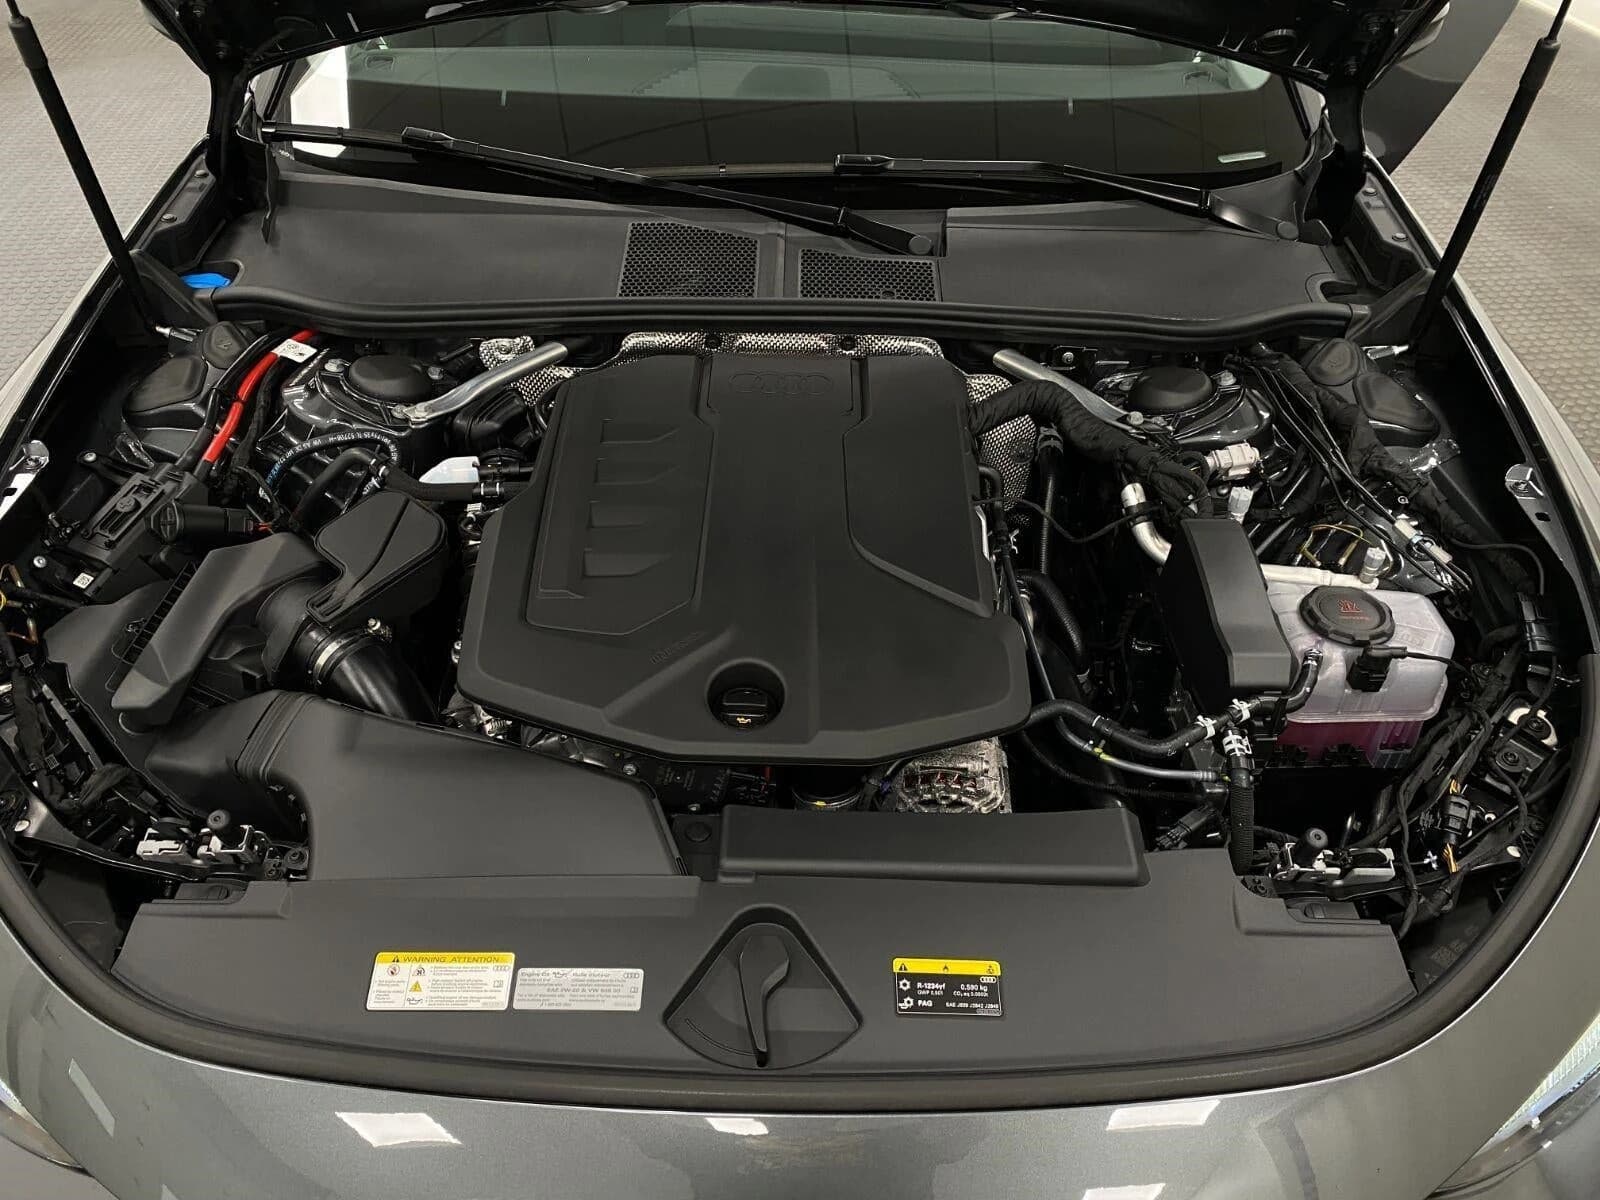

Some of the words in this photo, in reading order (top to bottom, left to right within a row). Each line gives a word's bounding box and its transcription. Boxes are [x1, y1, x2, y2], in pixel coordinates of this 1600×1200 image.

[403, 956, 447, 964] WARNING
[451, 956, 500, 964] ATTENTION
[918, 999, 933, 1007] PAG
